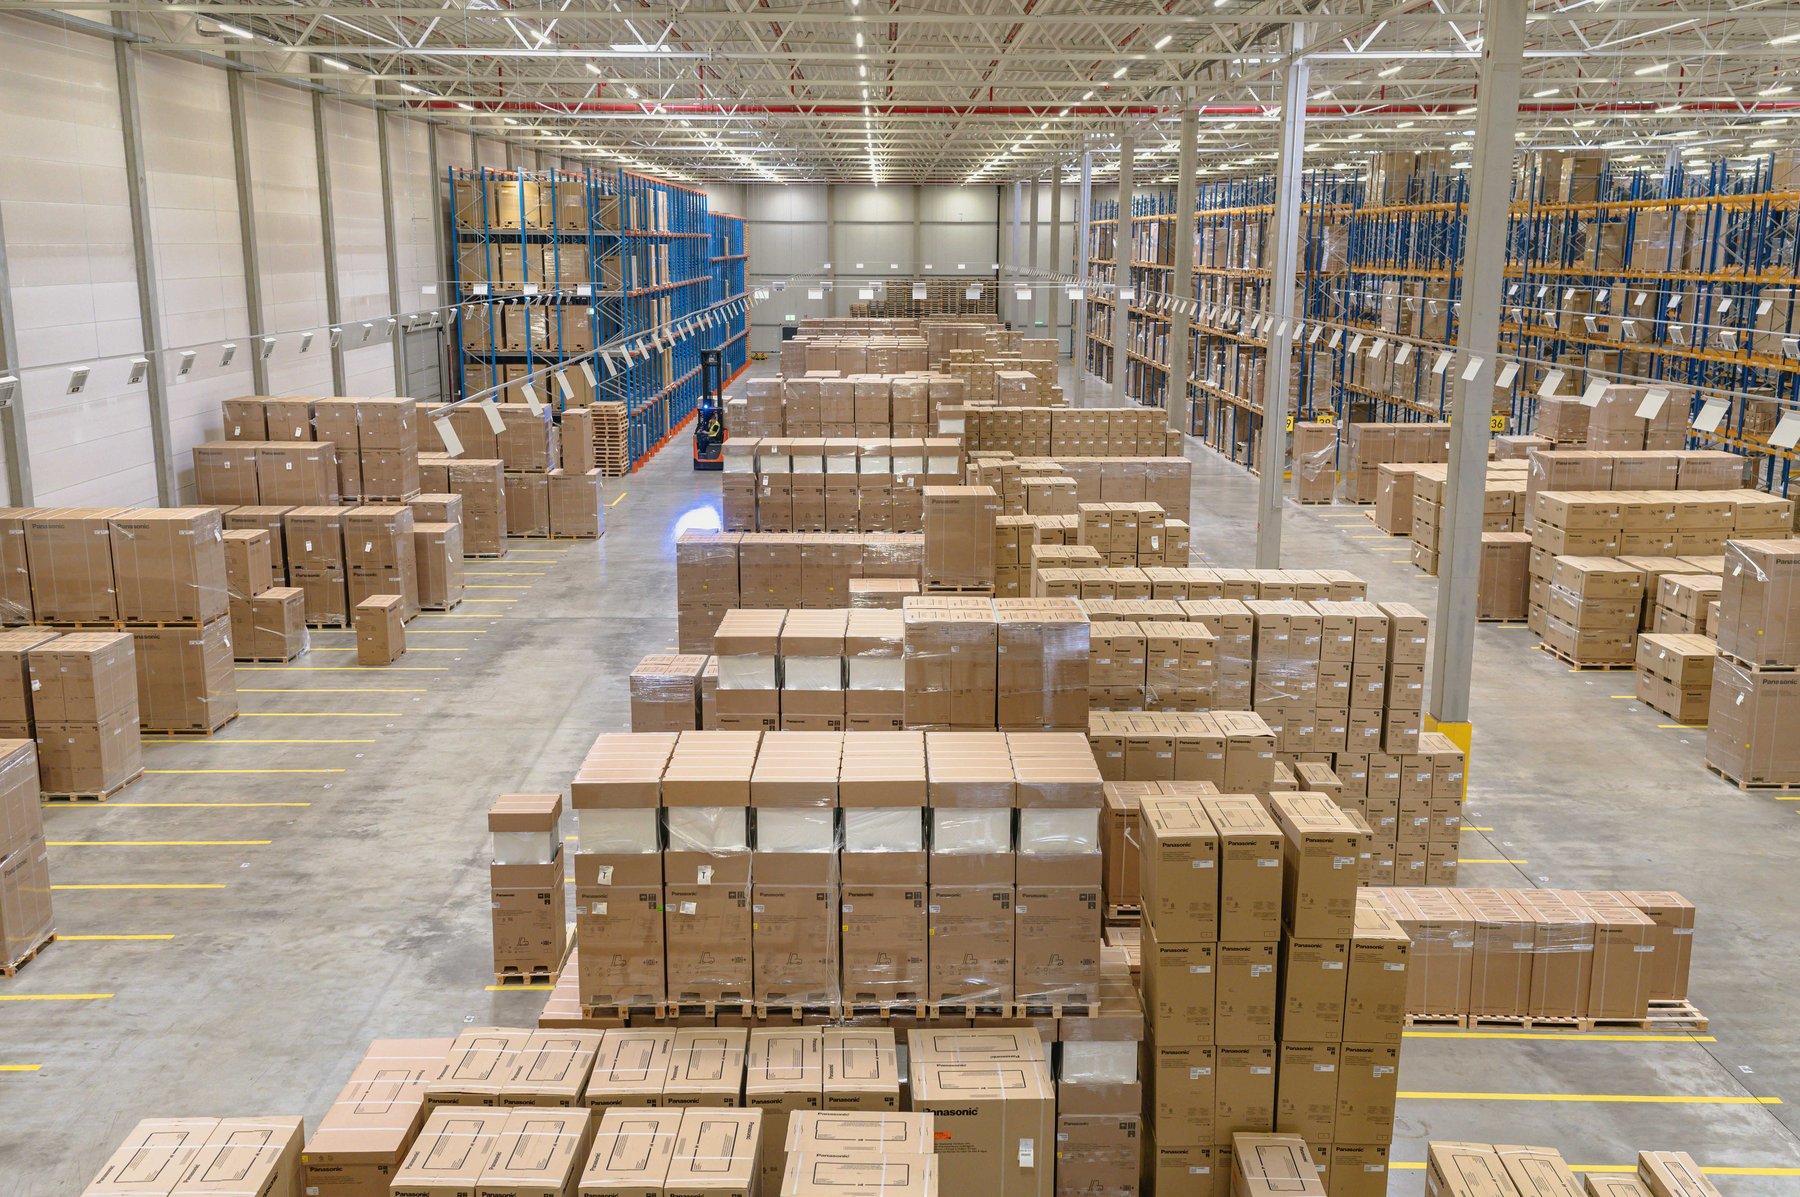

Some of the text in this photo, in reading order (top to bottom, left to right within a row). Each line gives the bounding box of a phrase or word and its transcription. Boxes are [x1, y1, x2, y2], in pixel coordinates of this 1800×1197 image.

[1490, 419, 1503, 429] 36
[1763, 678, 1798, 686] Panasonic
[602, 871, 607, 880] T
[702, 871, 706, 880] T
